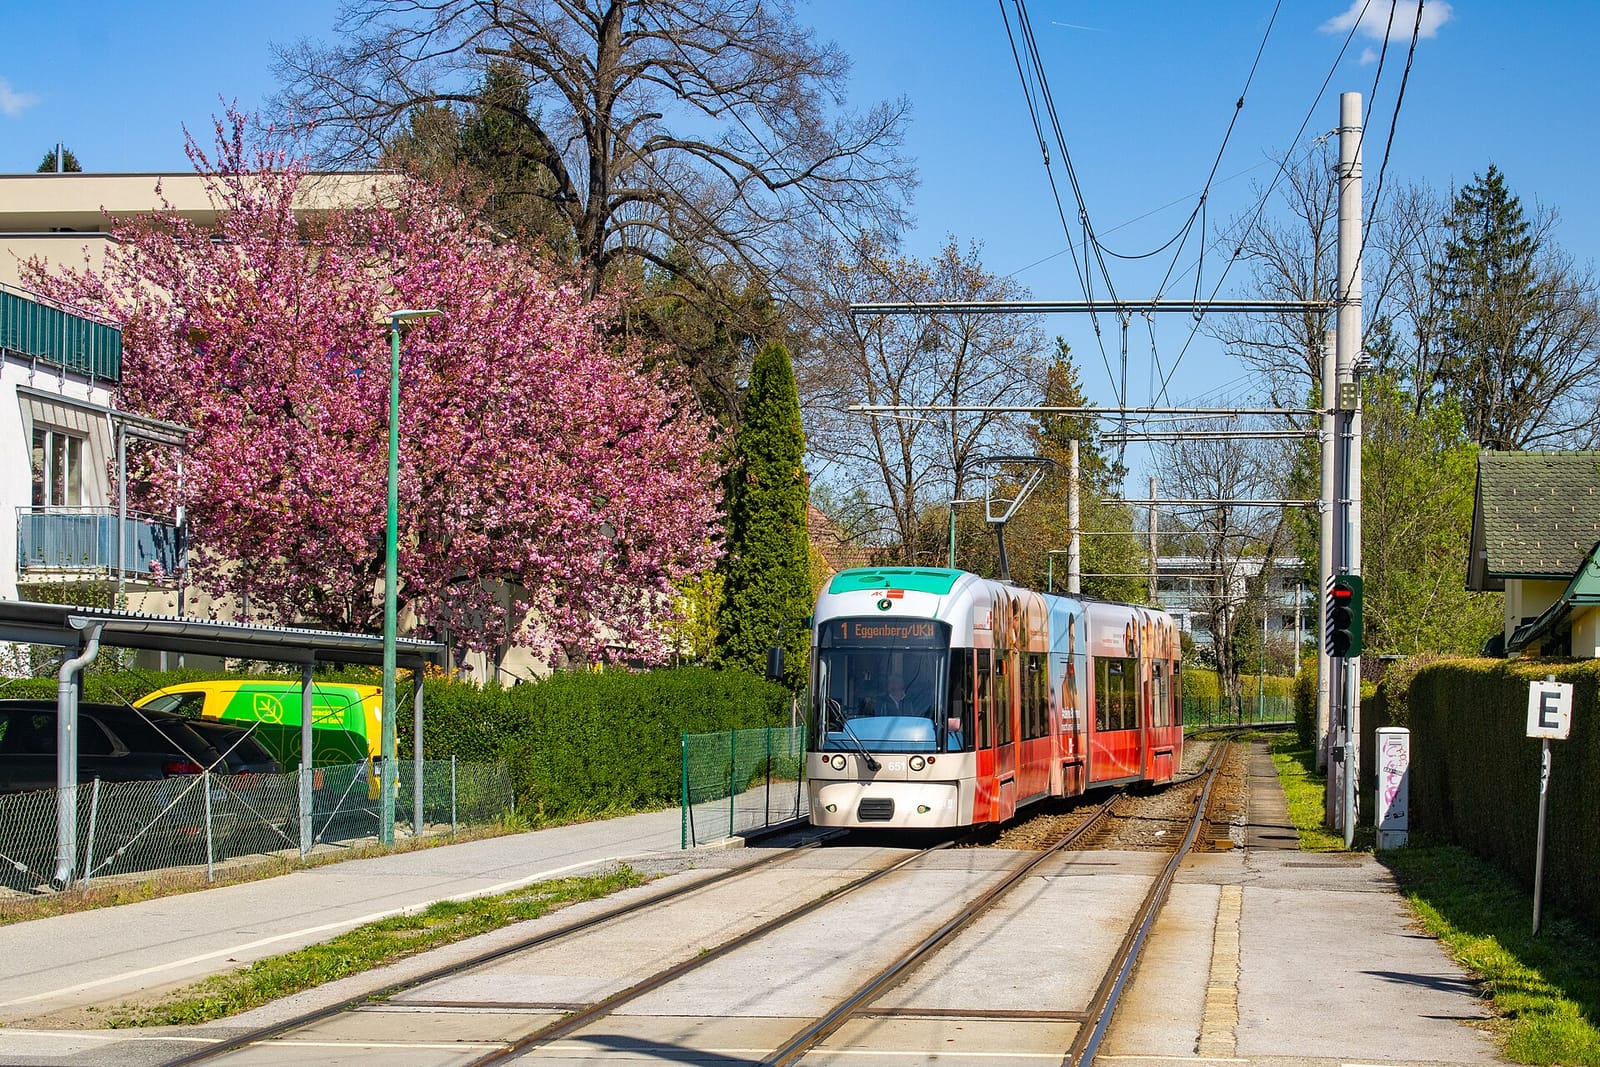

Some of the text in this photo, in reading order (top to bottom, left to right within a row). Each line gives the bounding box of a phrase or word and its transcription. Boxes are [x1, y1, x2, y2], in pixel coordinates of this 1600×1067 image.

[841, 622, 934, 639] 1 Eggenberg/UKH
[1538, 691, 1561, 729] E
[888, 761, 905, 771] 651
